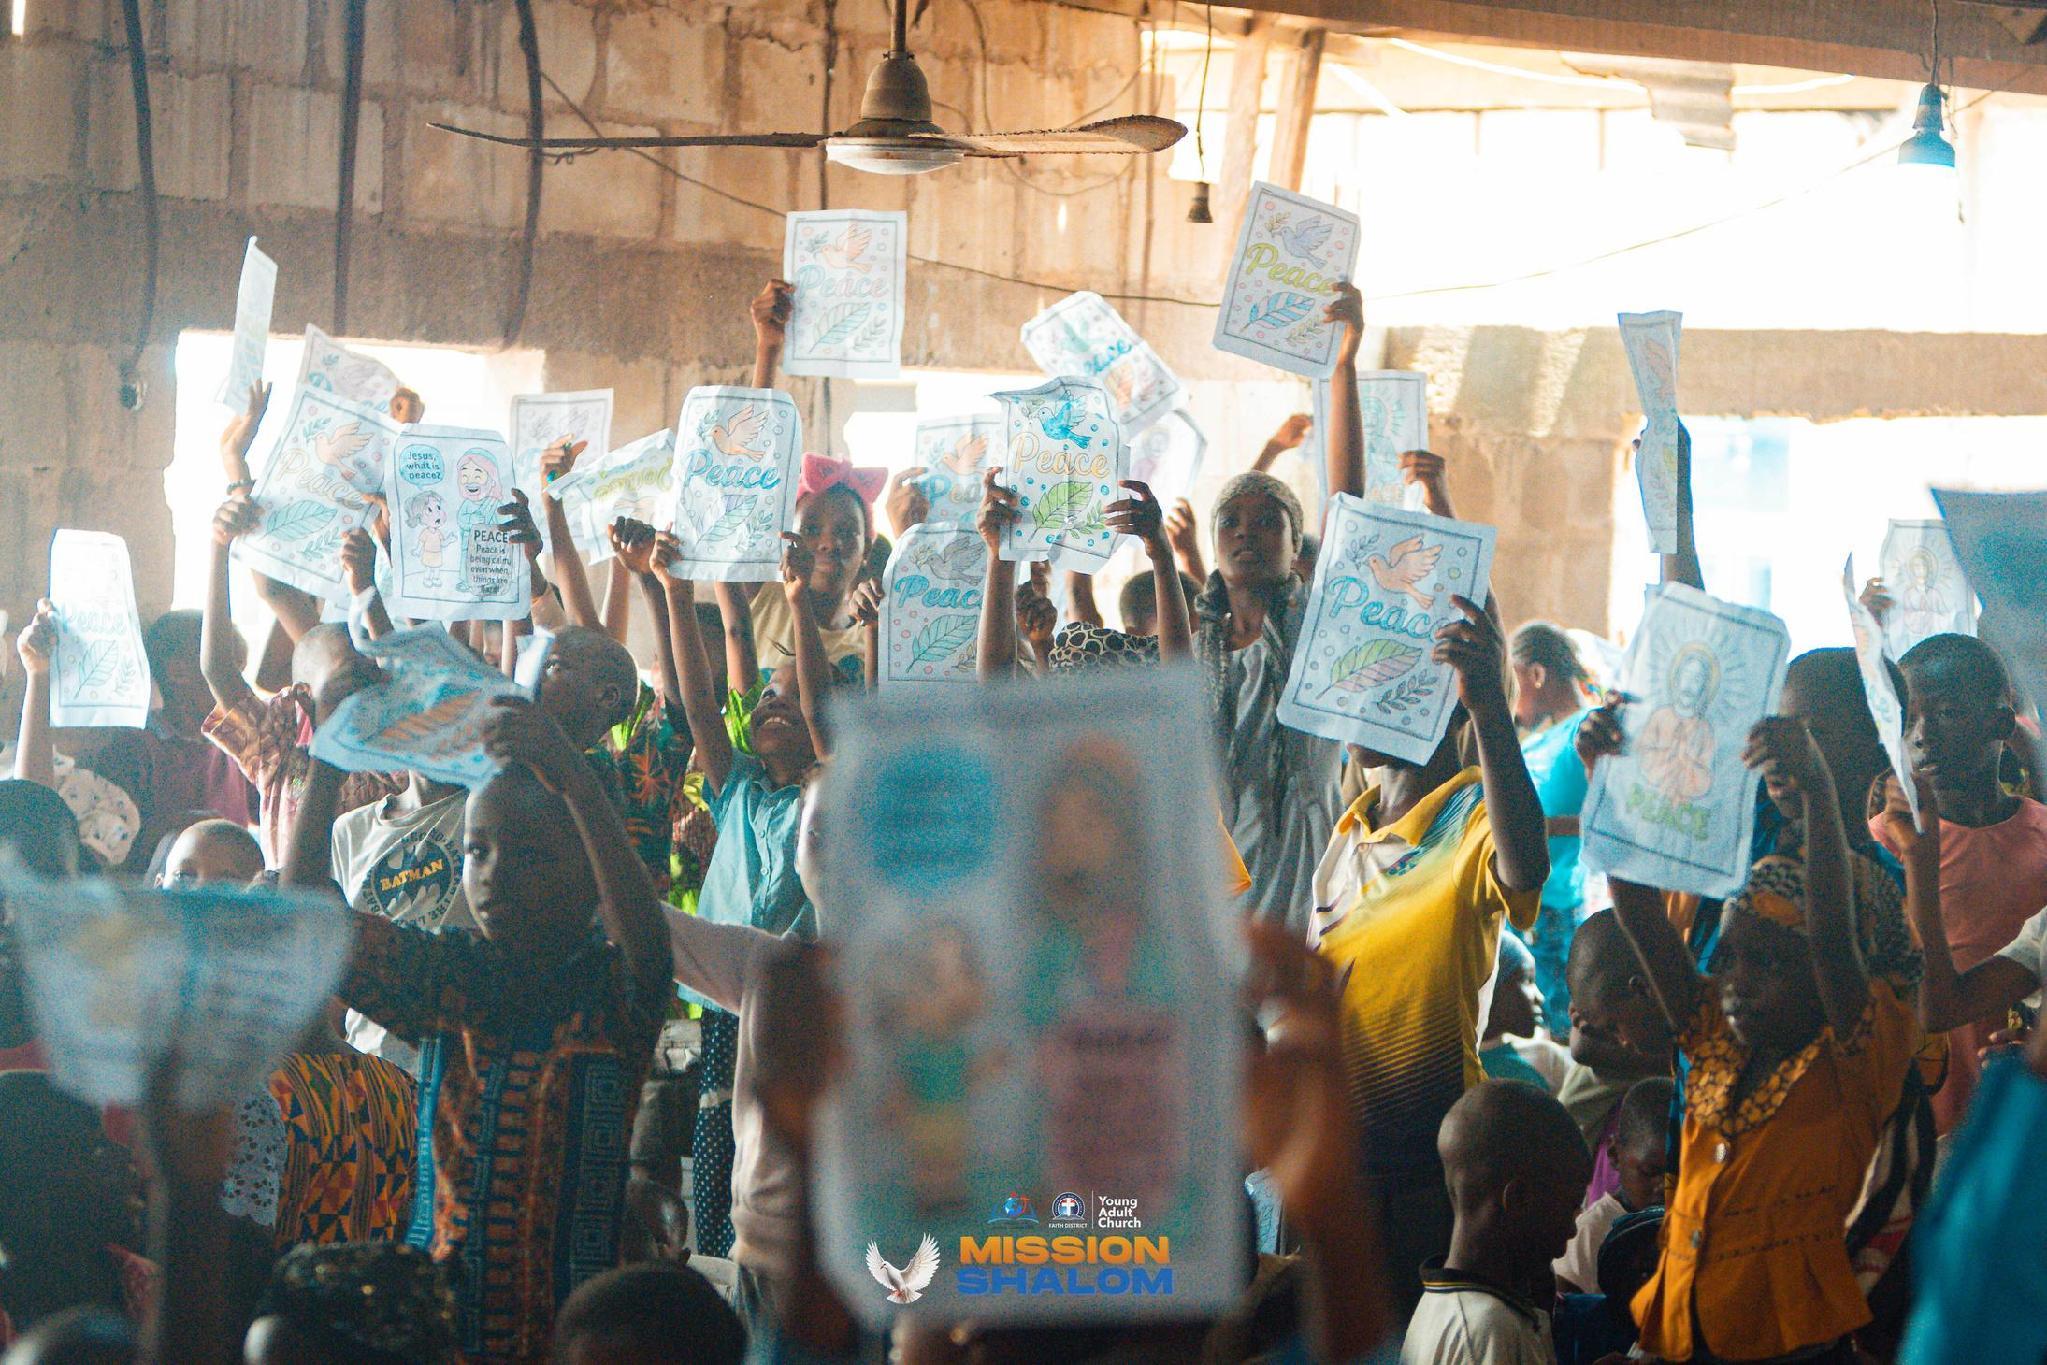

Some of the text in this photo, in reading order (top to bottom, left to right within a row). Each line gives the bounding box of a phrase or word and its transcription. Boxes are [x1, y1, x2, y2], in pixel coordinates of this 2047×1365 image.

[794, 264, 889, 299] Peace
[406, 461, 440, 471] what is
[684, 449, 781, 490] Peace
[1012, 431, 1110, 479] Peace
[409, 471, 441, 480] peace?
[473, 529, 509, 543] PEACE
[894, 574, 984, 610] Peac
[381, 858, 443, 892] BATMAN
